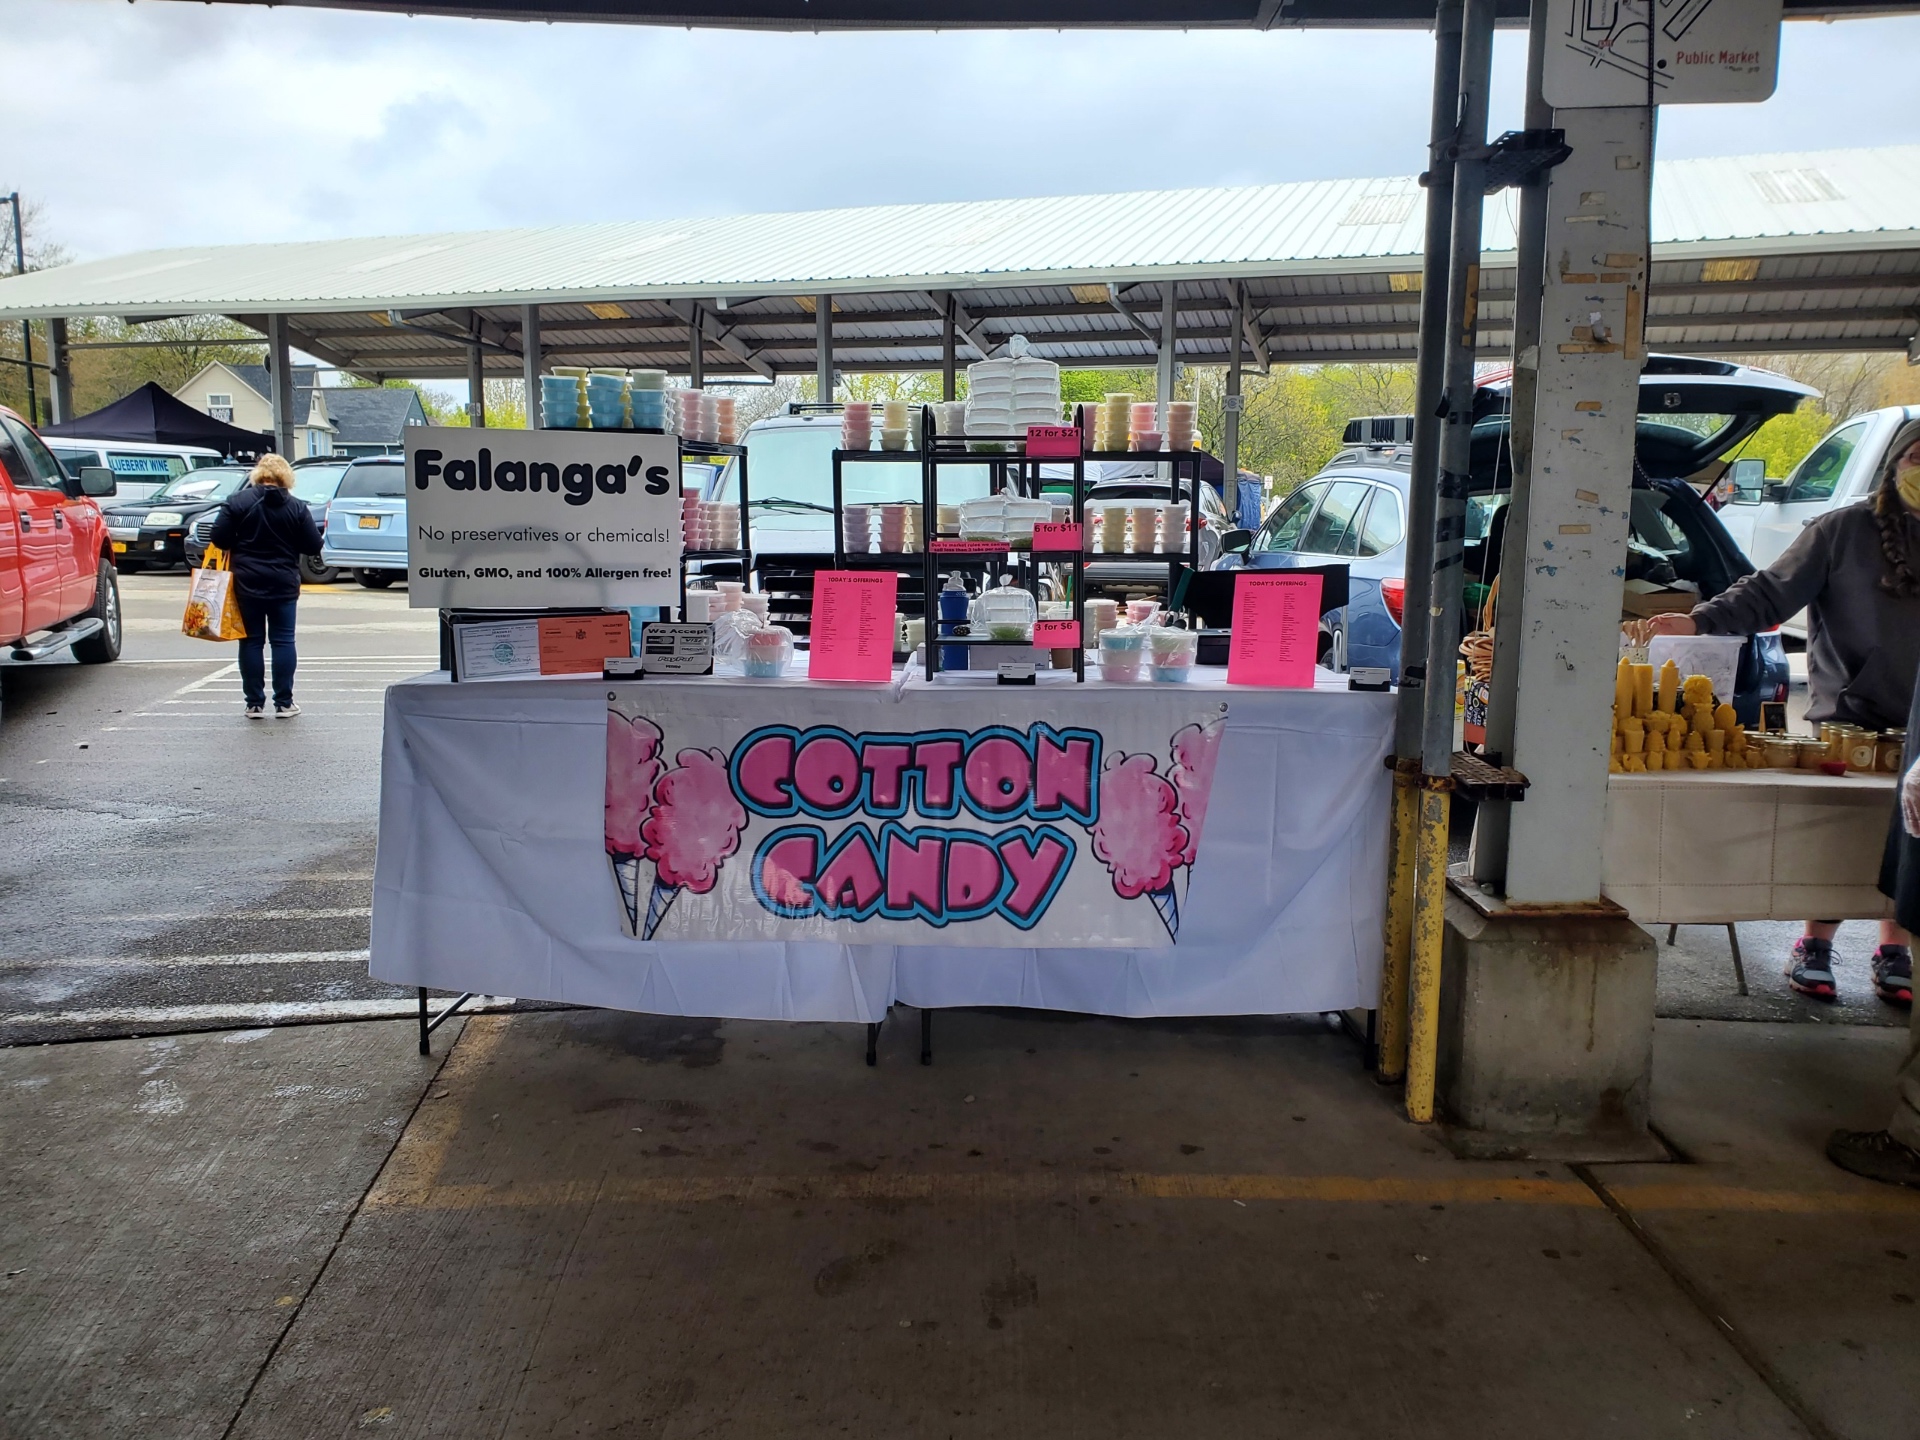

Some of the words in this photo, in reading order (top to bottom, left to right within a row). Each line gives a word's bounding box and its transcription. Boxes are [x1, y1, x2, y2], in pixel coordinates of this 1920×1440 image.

[1676, 51, 1714, 65] Public
[1718, 51, 1760, 64] Market
[1030, 429, 1041, 437] 12
[1044, 429, 1058, 437] for
[1061, 429, 1079, 438] $21
[149, 459, 169, 472] WINE
[414, 448, 670, 506] Falanga's
[418, 525, 445, 541] No
[451, 526, 559, 544] preservatives
[564, 531, 582, 542] or
[587, 527, 671, 543] chemicals!
[1034, 524, 1040, 532] 6
[1043, 524, 1057, 532] for
[1060, 523, 1078, 532] $11
[418, 567, 470, 579] Gluten,
[474, 567, 513, 579] GMO,
[516, 567, 541, 578] and
[546, 567, 581, 578] 100%
[584, 566, 639, 580] Allergen
[642, 567, 672, 578] free!
[1044, 623, 1058, 631] for
[1060, 622, 1073, 630] $6
[729, 722, 1101, 826] COTTON
[750, 821, 1077, 929] CANDY
